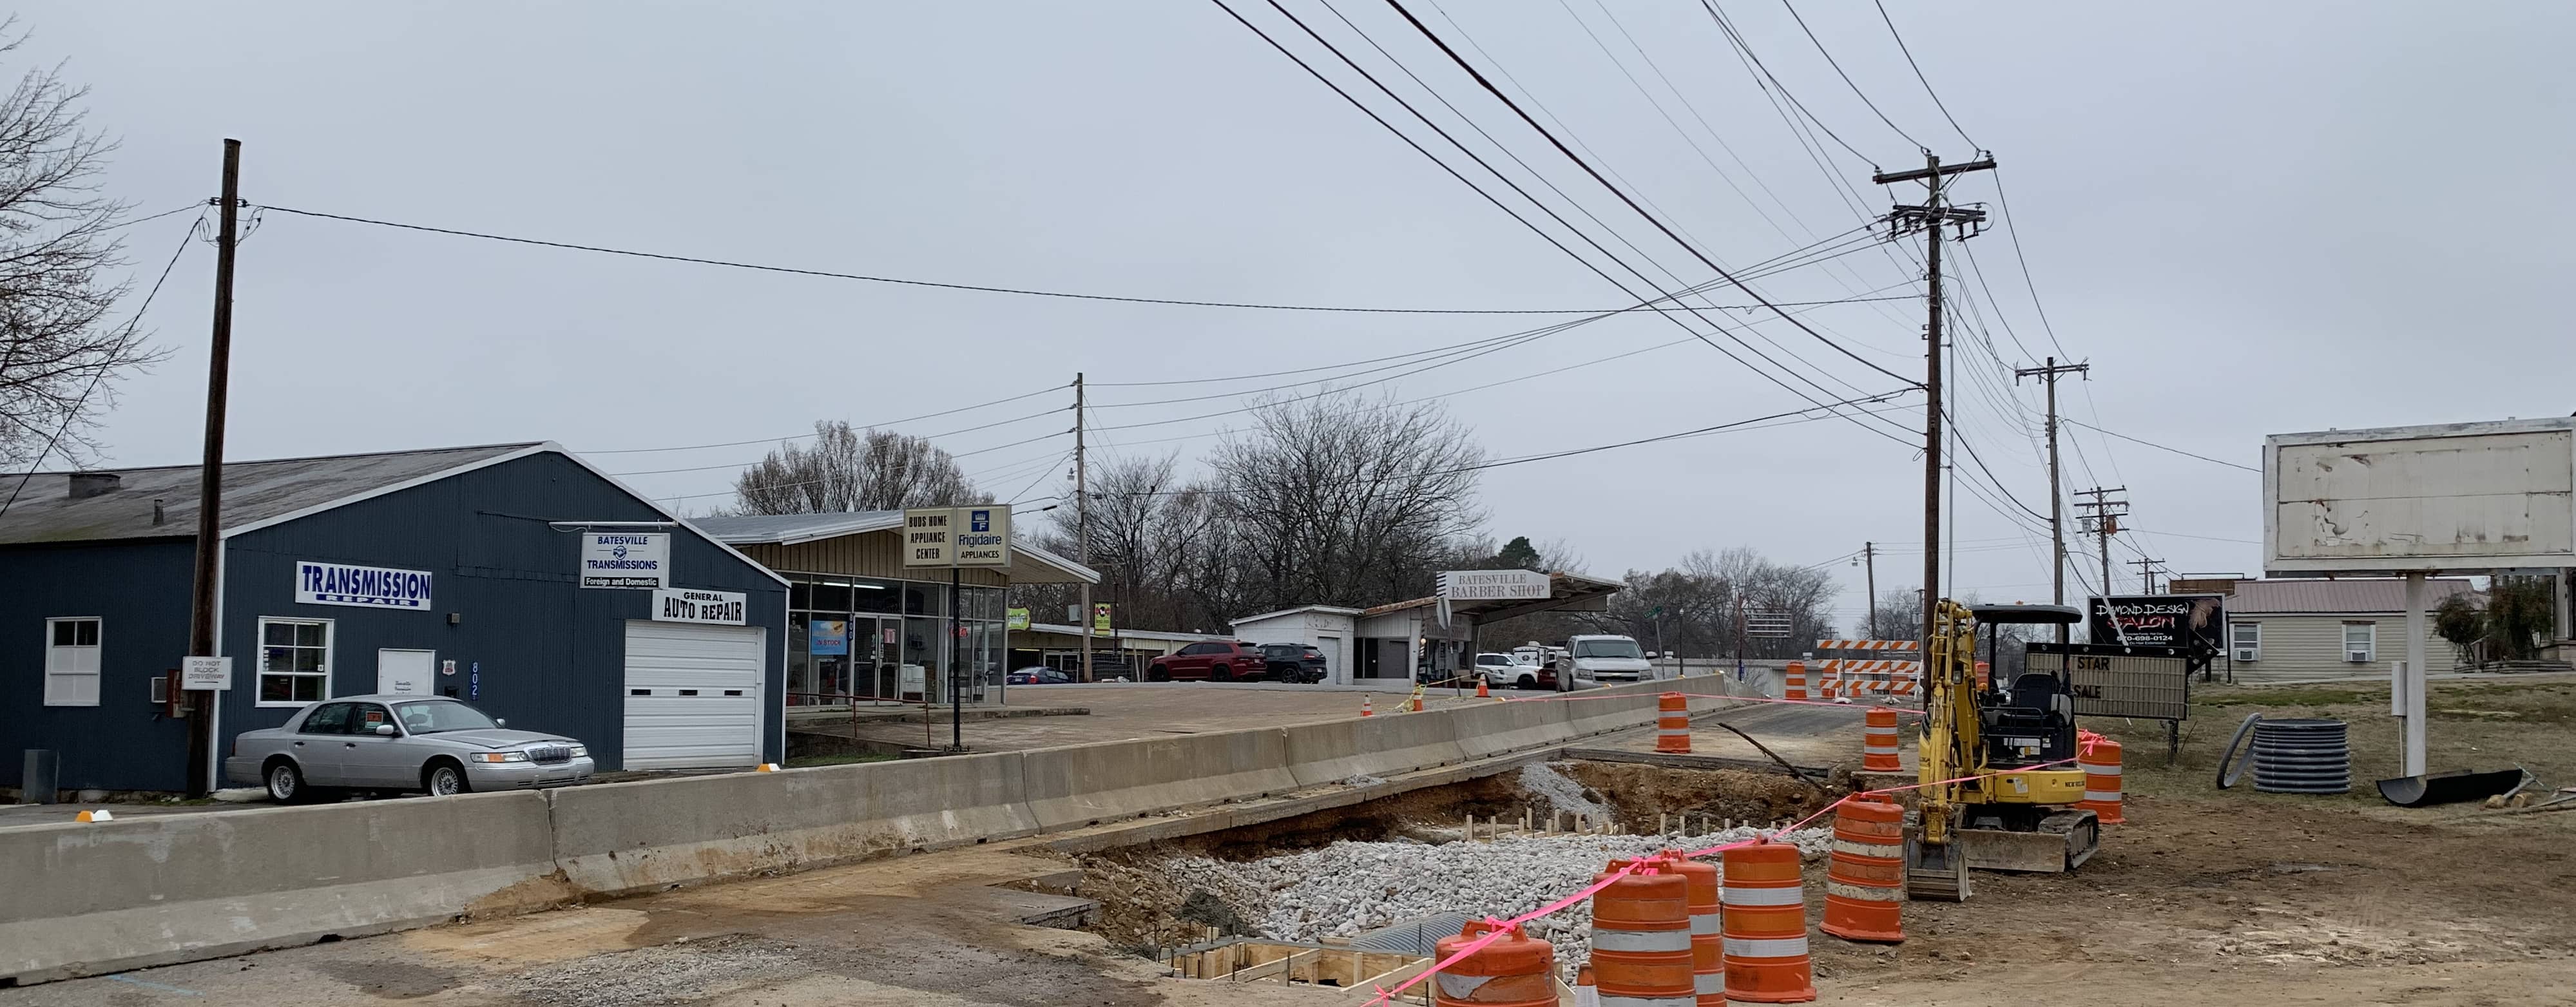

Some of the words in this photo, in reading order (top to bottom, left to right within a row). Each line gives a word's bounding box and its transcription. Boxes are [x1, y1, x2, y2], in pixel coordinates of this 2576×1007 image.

[909, 516, 927, 527] BUDS
[928, 515, 947, 526] HOME
[597, 536, 648, 544] BATESVILLE
[910, 532, 945, 543] APPLIANCE
[959, 534, 1002, 548] Frigidaire
[916, 548, 940, 559] CENTER
[961, 550, 999, 559] APPLIANCES
[587, 560, 658, 570] TRANSMISSIONS
[302, 565, 431, 599] TRANSMISSION
[586, 577, 610, 586] Foreign
[625, 578, 657, 586] Domestic
[1459, 574, 1527, 584] BATESVILLE
[684, 591, 724, 602] GENERAL
[1451, 585, 1505, 598] BARBER
[1510, 584, 1544, 597] SHOP
[325, 595, 411, 606] REPAIR
[664, 597, 696, 619] AUTO
[701, 601, 742, 621] REPAIR
[2095, 602, 2143, 616] DAMOND
[2144, 602, 2189, 615] DESIGN
[2077, 656, 2110, 670] STAR
[2073, 684, 2101, 698] SALE
